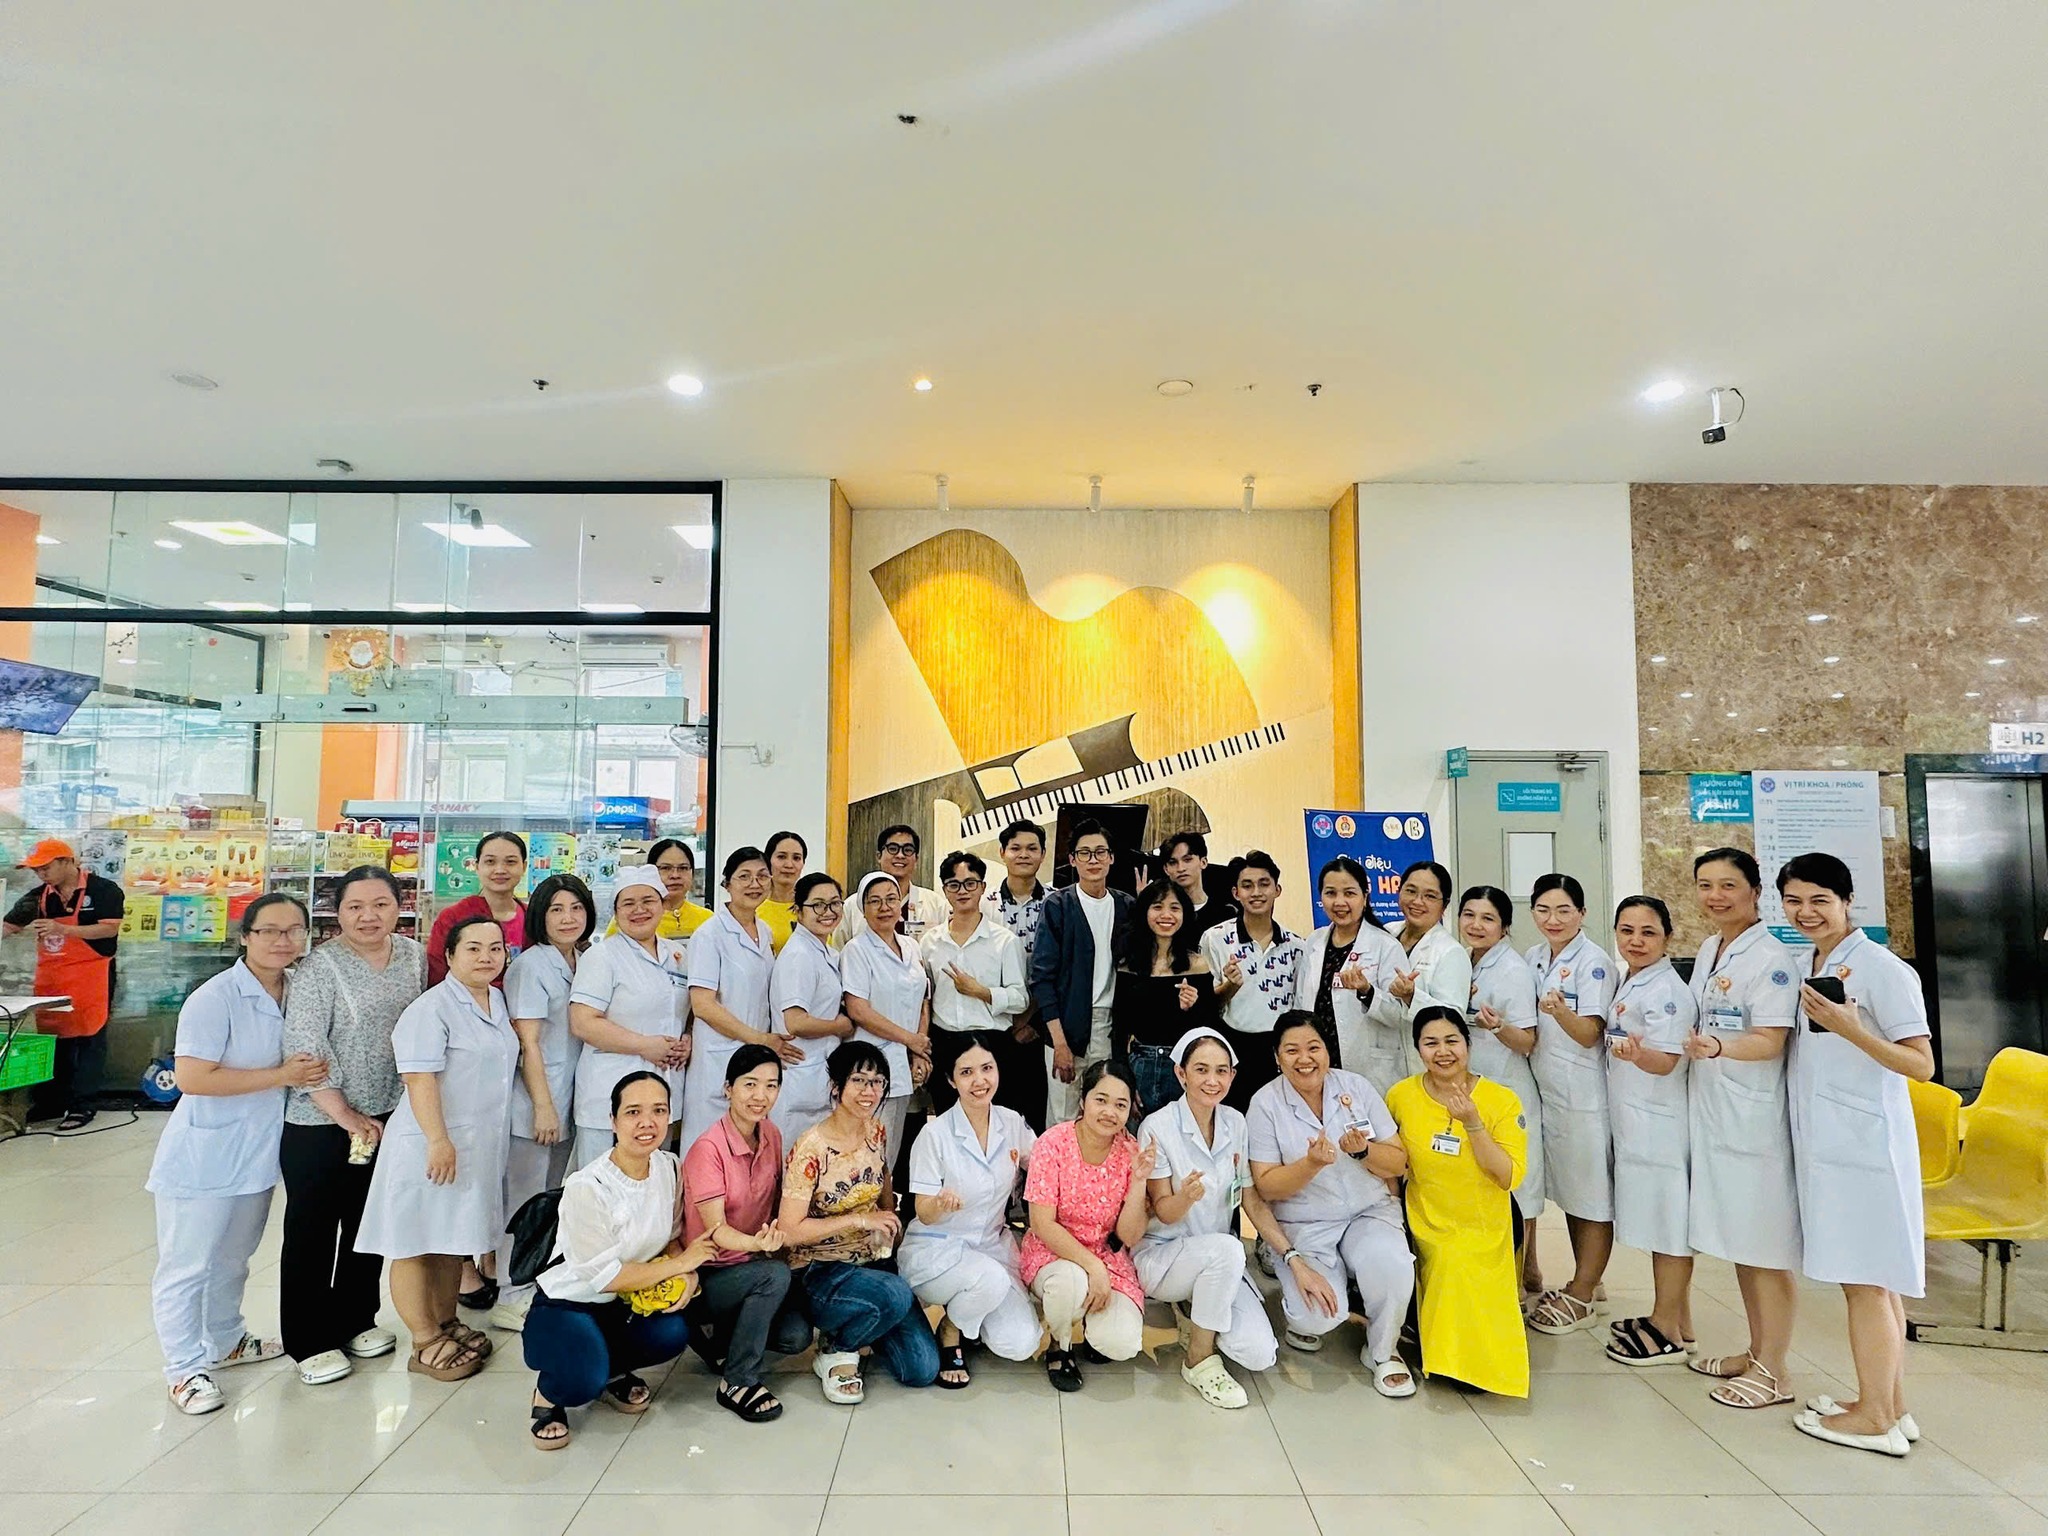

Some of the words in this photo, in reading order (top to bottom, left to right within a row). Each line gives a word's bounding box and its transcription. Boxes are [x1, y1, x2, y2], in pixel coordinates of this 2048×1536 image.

[2022, 731, 2045, 746] H2
[1807, 781, 1830, 789] KHOA
[429, 803, 481, 813] SANAKY
[606, 803, 638, 816] pepsi
